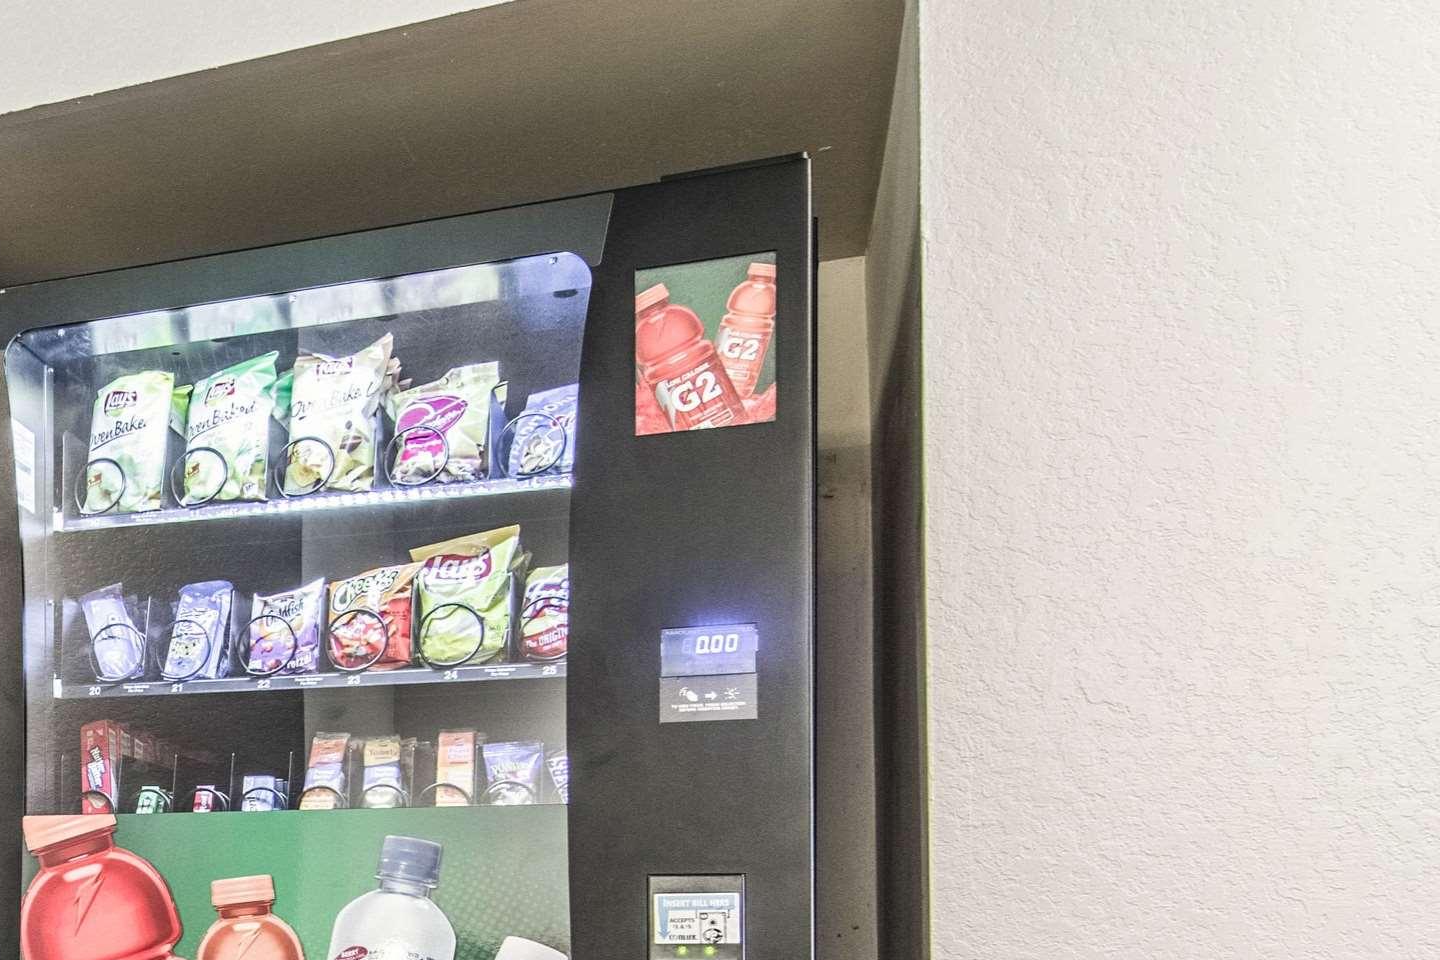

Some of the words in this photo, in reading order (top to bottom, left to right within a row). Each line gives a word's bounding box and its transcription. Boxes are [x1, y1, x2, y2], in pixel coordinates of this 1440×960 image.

[723, 337, 759, 361] G2
[671, 371, 723, 413] G2
[89, 687, 101, 696] 20
[171, 684, 183, 693] 21
[257, 680, 271, 689] 22
[347, 676, 361, 685] 23
[443, 670, 459, 680] 24
[542, 667, 557, 676] 25
